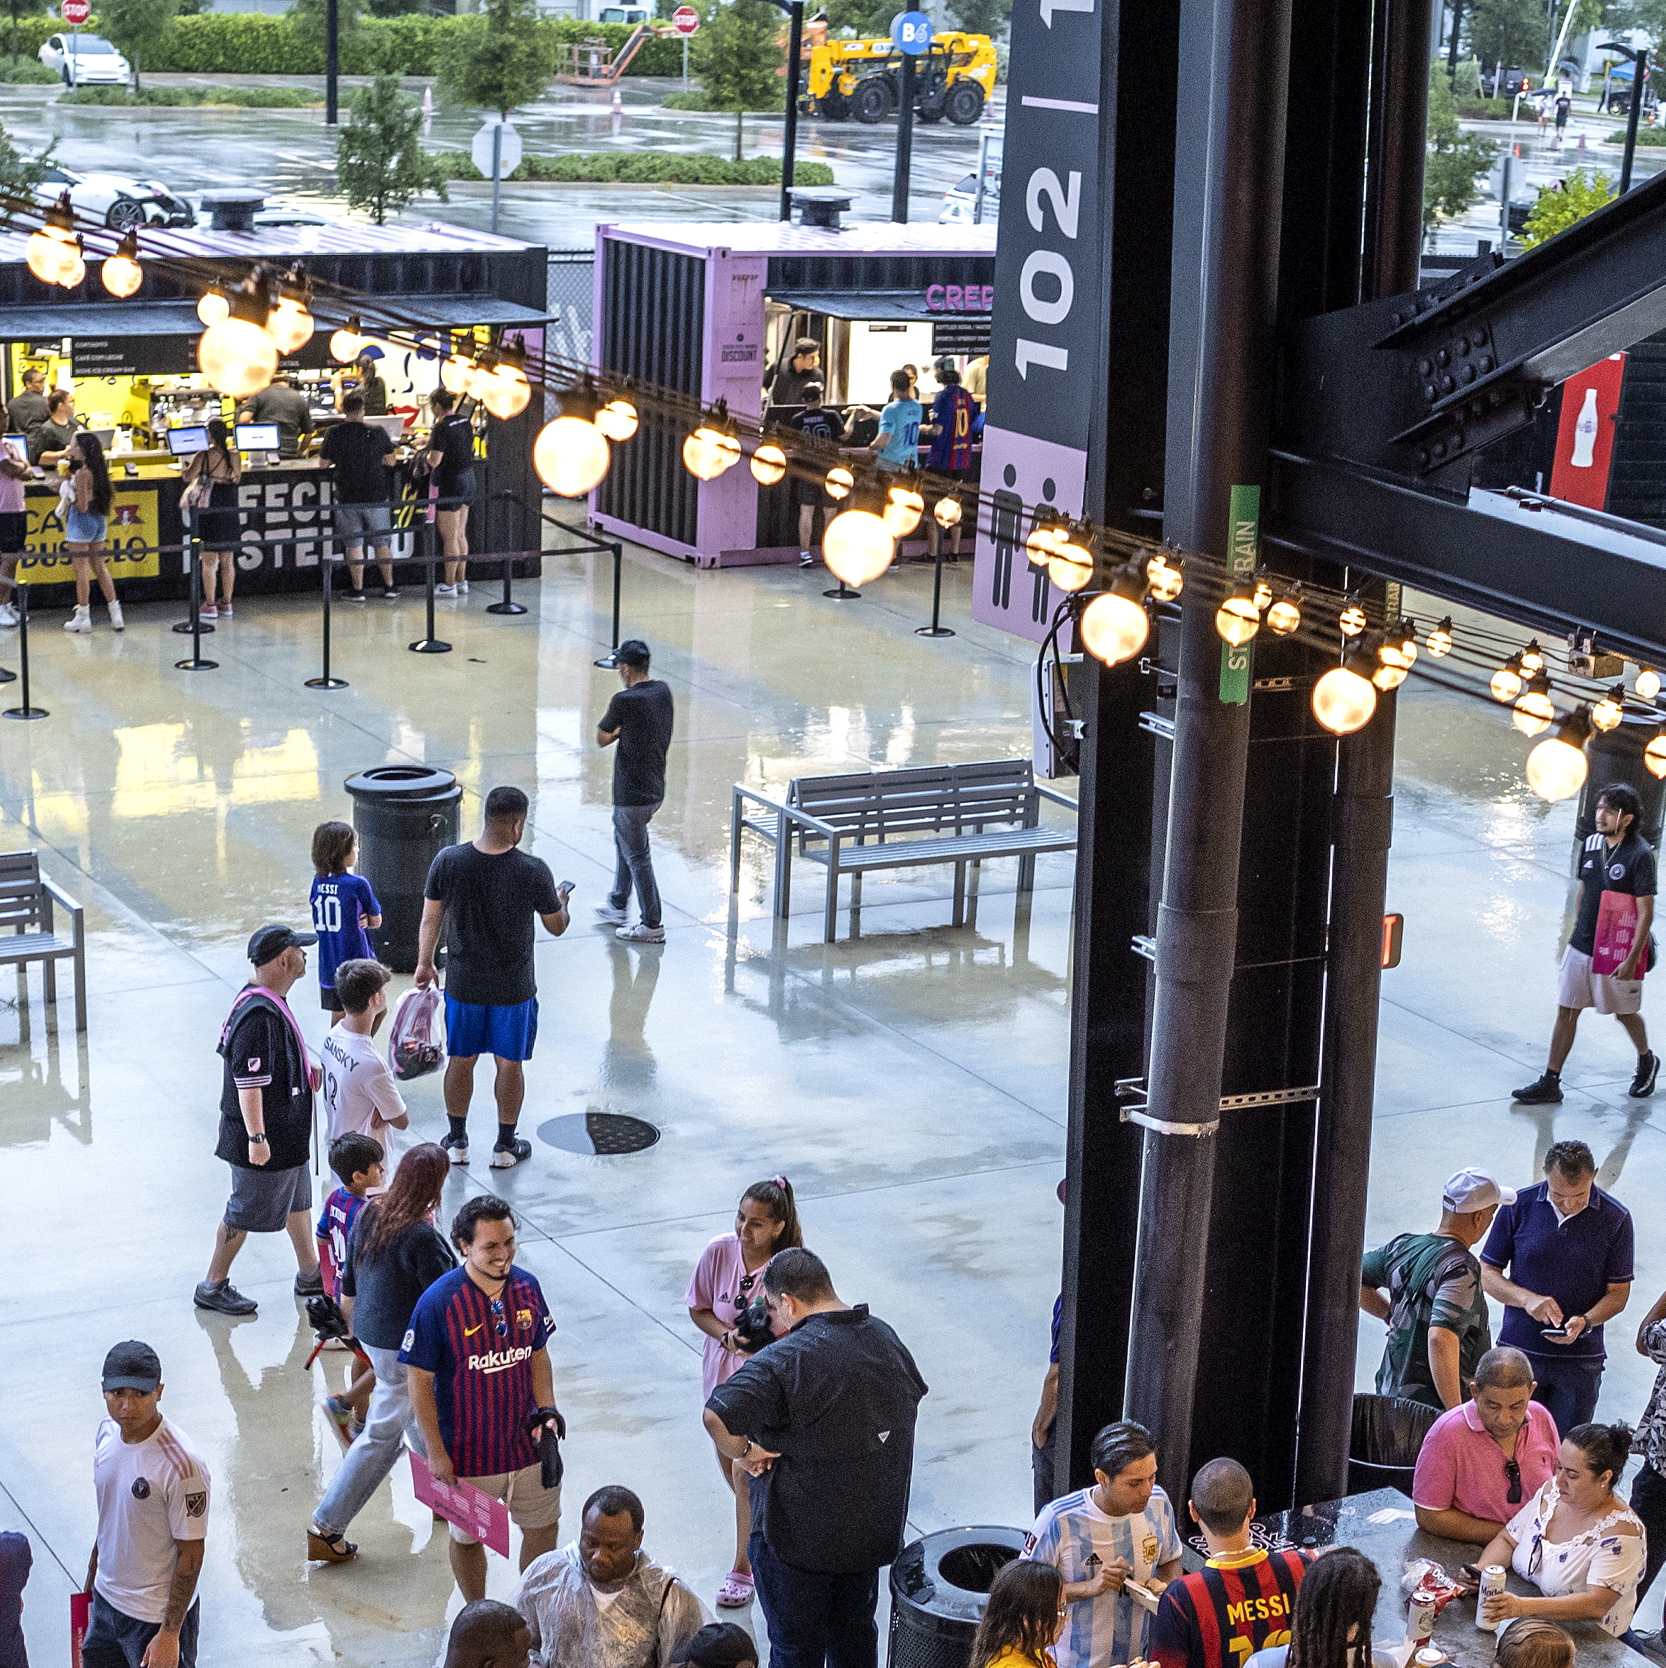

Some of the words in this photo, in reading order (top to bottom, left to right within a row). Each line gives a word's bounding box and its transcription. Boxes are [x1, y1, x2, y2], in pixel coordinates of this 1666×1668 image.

[674, 14, 698, 26] STOP
[902, 22, 928, 44] B6
[1014, 166, 1083, 381] 102
[721, 349, 758, 362] DISCOUNT
[21, 536, 149, 569] BUSLO
[1232, 520, 1257, 572] RAIN
[314, 895, 341, 932] 10
[467, 1345, 533, 1371] Rakuten
[1226, 1593, 1291, 1625] MESSI
